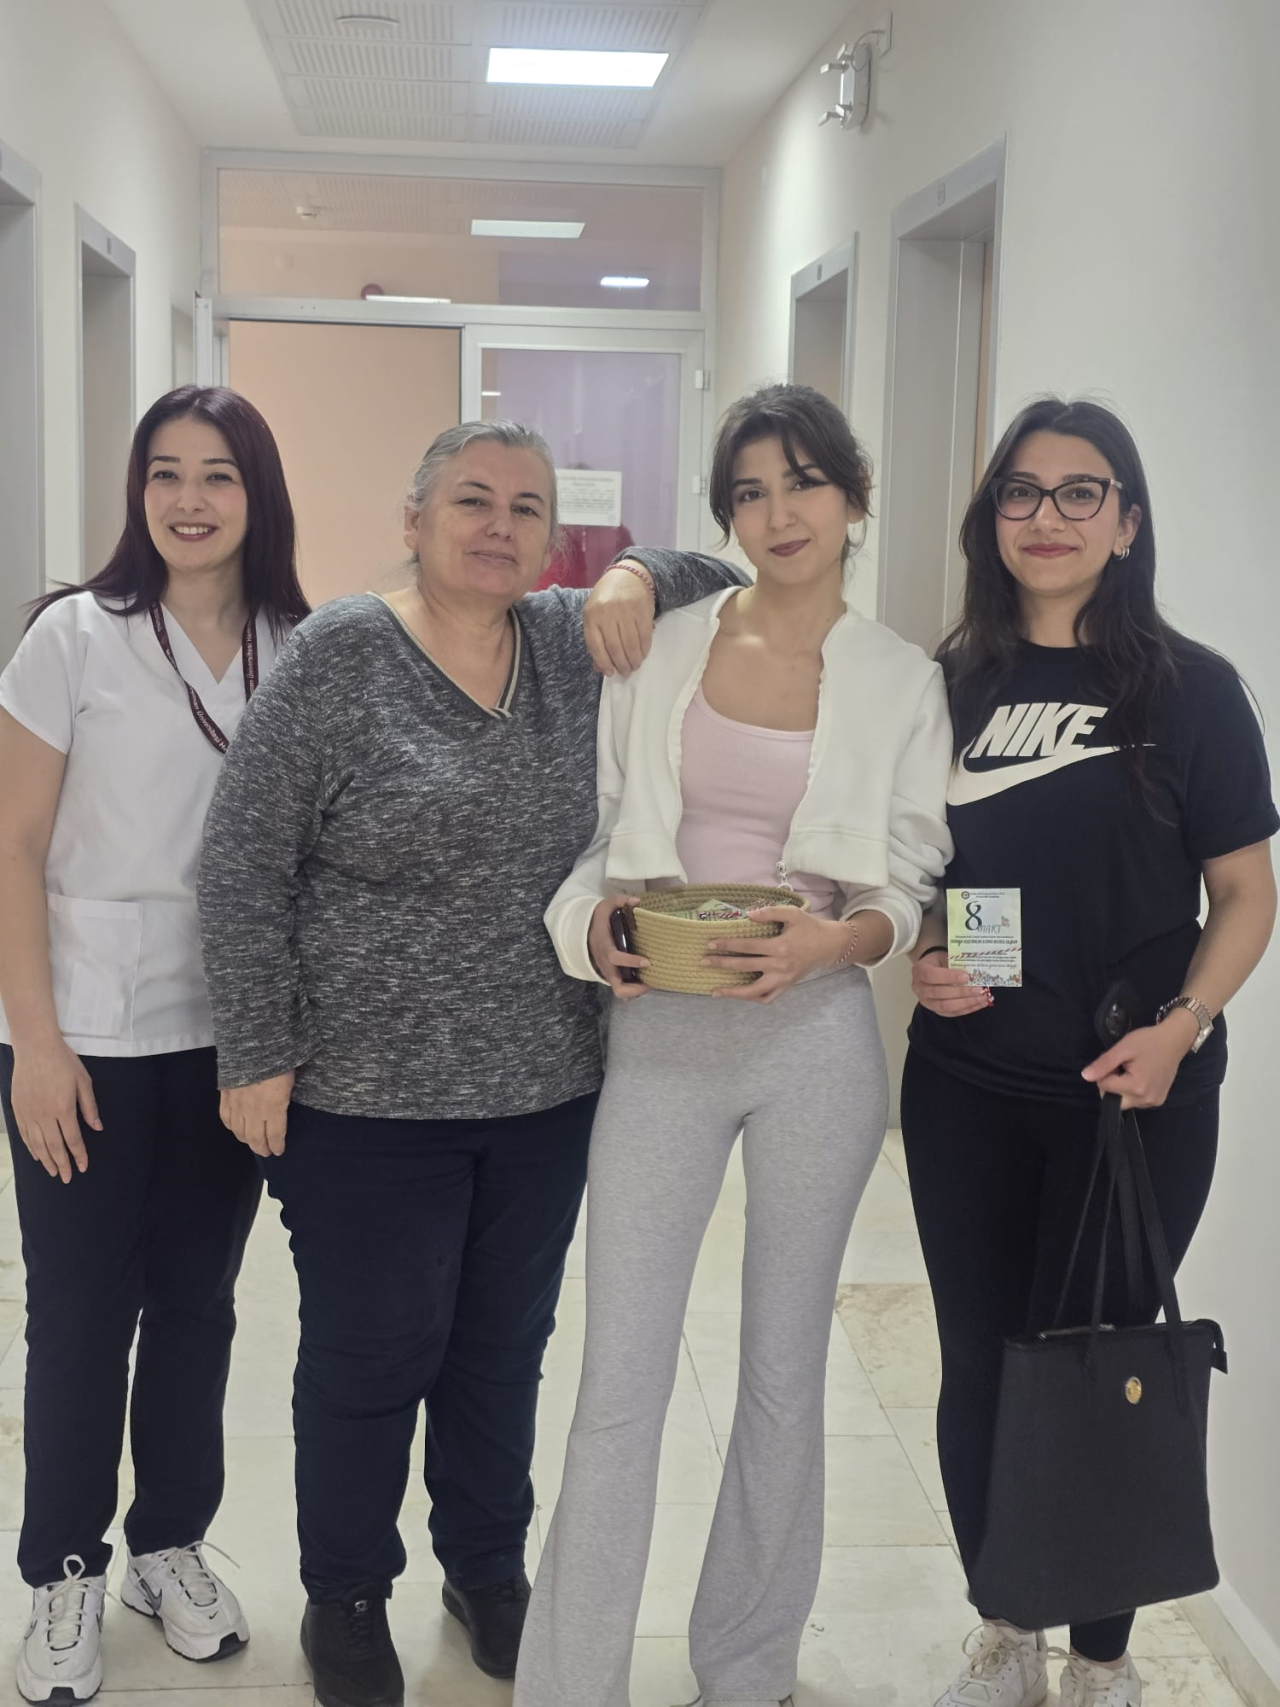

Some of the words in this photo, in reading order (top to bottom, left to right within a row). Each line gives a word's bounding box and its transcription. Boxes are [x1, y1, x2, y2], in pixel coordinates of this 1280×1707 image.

[196, 710, 221, 744] Üniversitesi
[969, 702, 1108, 759] NIKE
[965, 901, 982, 931] 8
